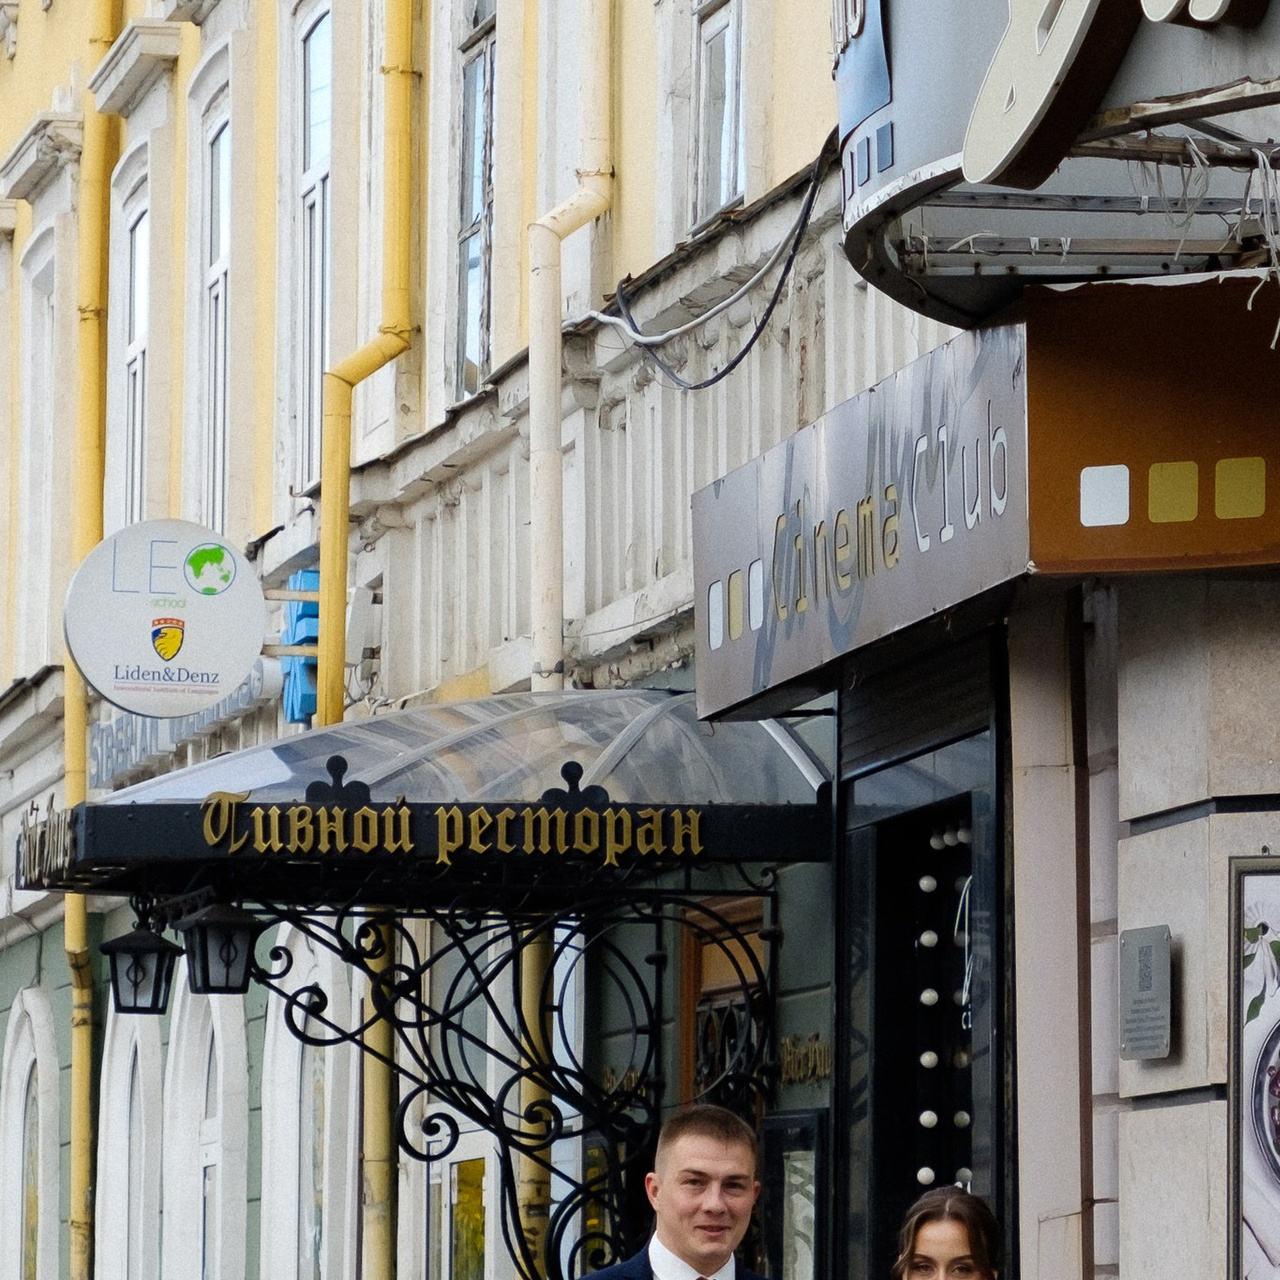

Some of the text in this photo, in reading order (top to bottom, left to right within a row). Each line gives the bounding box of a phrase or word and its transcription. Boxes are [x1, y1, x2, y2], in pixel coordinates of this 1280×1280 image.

[772, 399, 1008, 622] Cinema Club
[113, 665, 220, 685] Liden&Denz
[434, 805, 705, 866] ресторан
